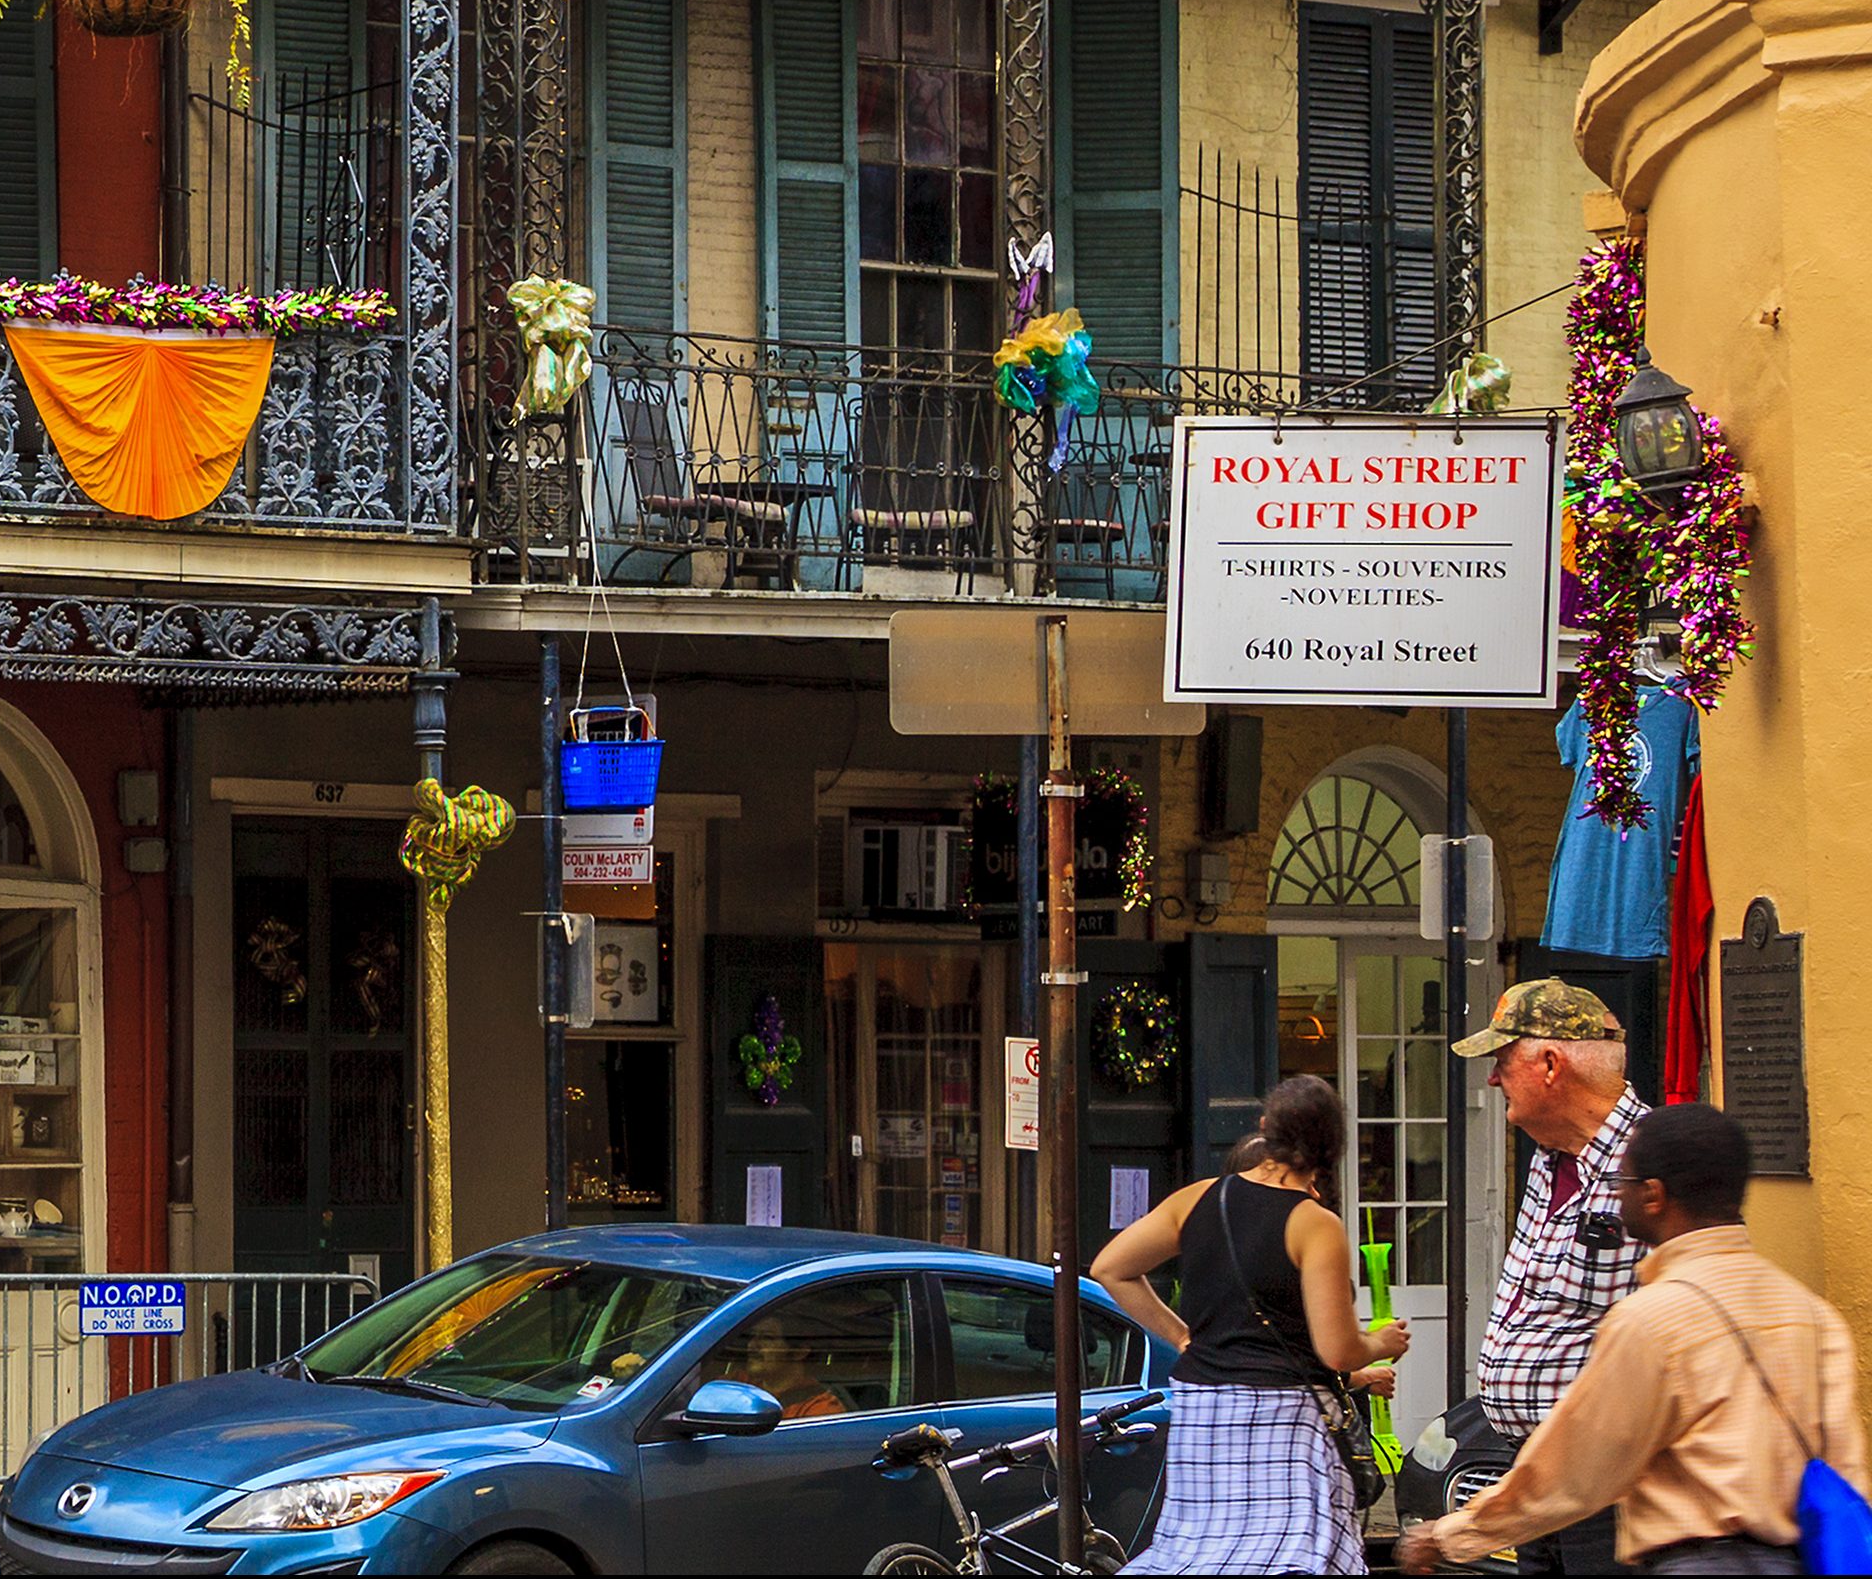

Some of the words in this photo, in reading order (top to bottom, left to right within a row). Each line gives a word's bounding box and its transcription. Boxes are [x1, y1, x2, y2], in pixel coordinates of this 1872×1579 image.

[1212, 456, 1353, 484] ROYAL
[1363, 456, 1527, 484] STREET
[1256, 501, 1355, 530] GIFT
[1366, 502, 1479, 530] SHOP
[1222, 559, 1336, 578] T-SHIRTS
[1357, 560, 1507, 579] SOUVENIRS
[1245, 638, 1293, 661] 640
[1303, 638, 1384, 667] Royal
[1394, 639, 1479, 663] Street
[315, 784, 345, 803] 637
[563, 853, 594, 866] COLIN
[597, 852, 644, 866] McLARTY
[104, 1309, 135, 1319] POLICE
[144, 1308, 163, 1318] LINE
[92, 1320, 108, 1330] DO
[116, 1320, 135, 1330] NOT
[143, 1319, 174, 1329] CROSS
